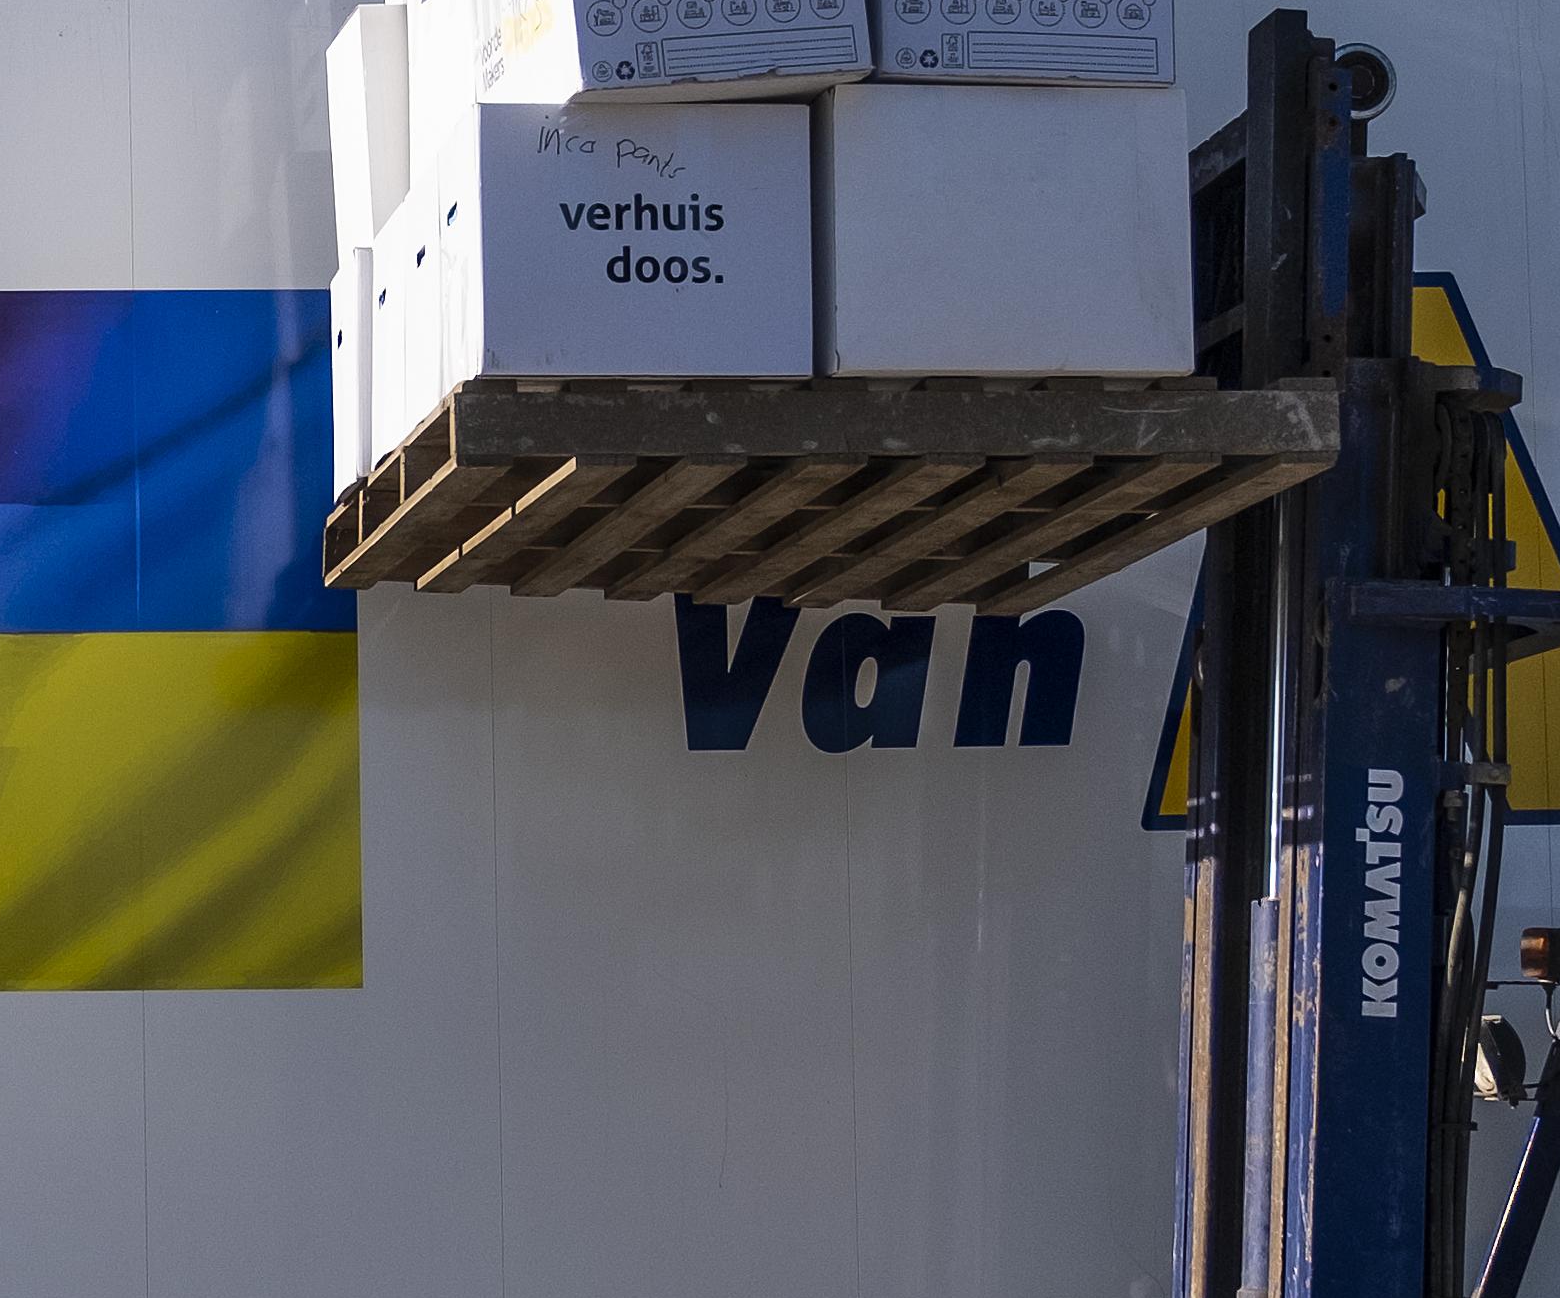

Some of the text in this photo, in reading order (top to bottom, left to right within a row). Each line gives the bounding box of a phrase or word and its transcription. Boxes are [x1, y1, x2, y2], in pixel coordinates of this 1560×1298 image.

[559, 193, 725, 232] verhuis
[606, 245, 725, 284] doos.
[673, 593, 1086, 754] Van
[1359, 767, 1405, 1019] KOMATSU
